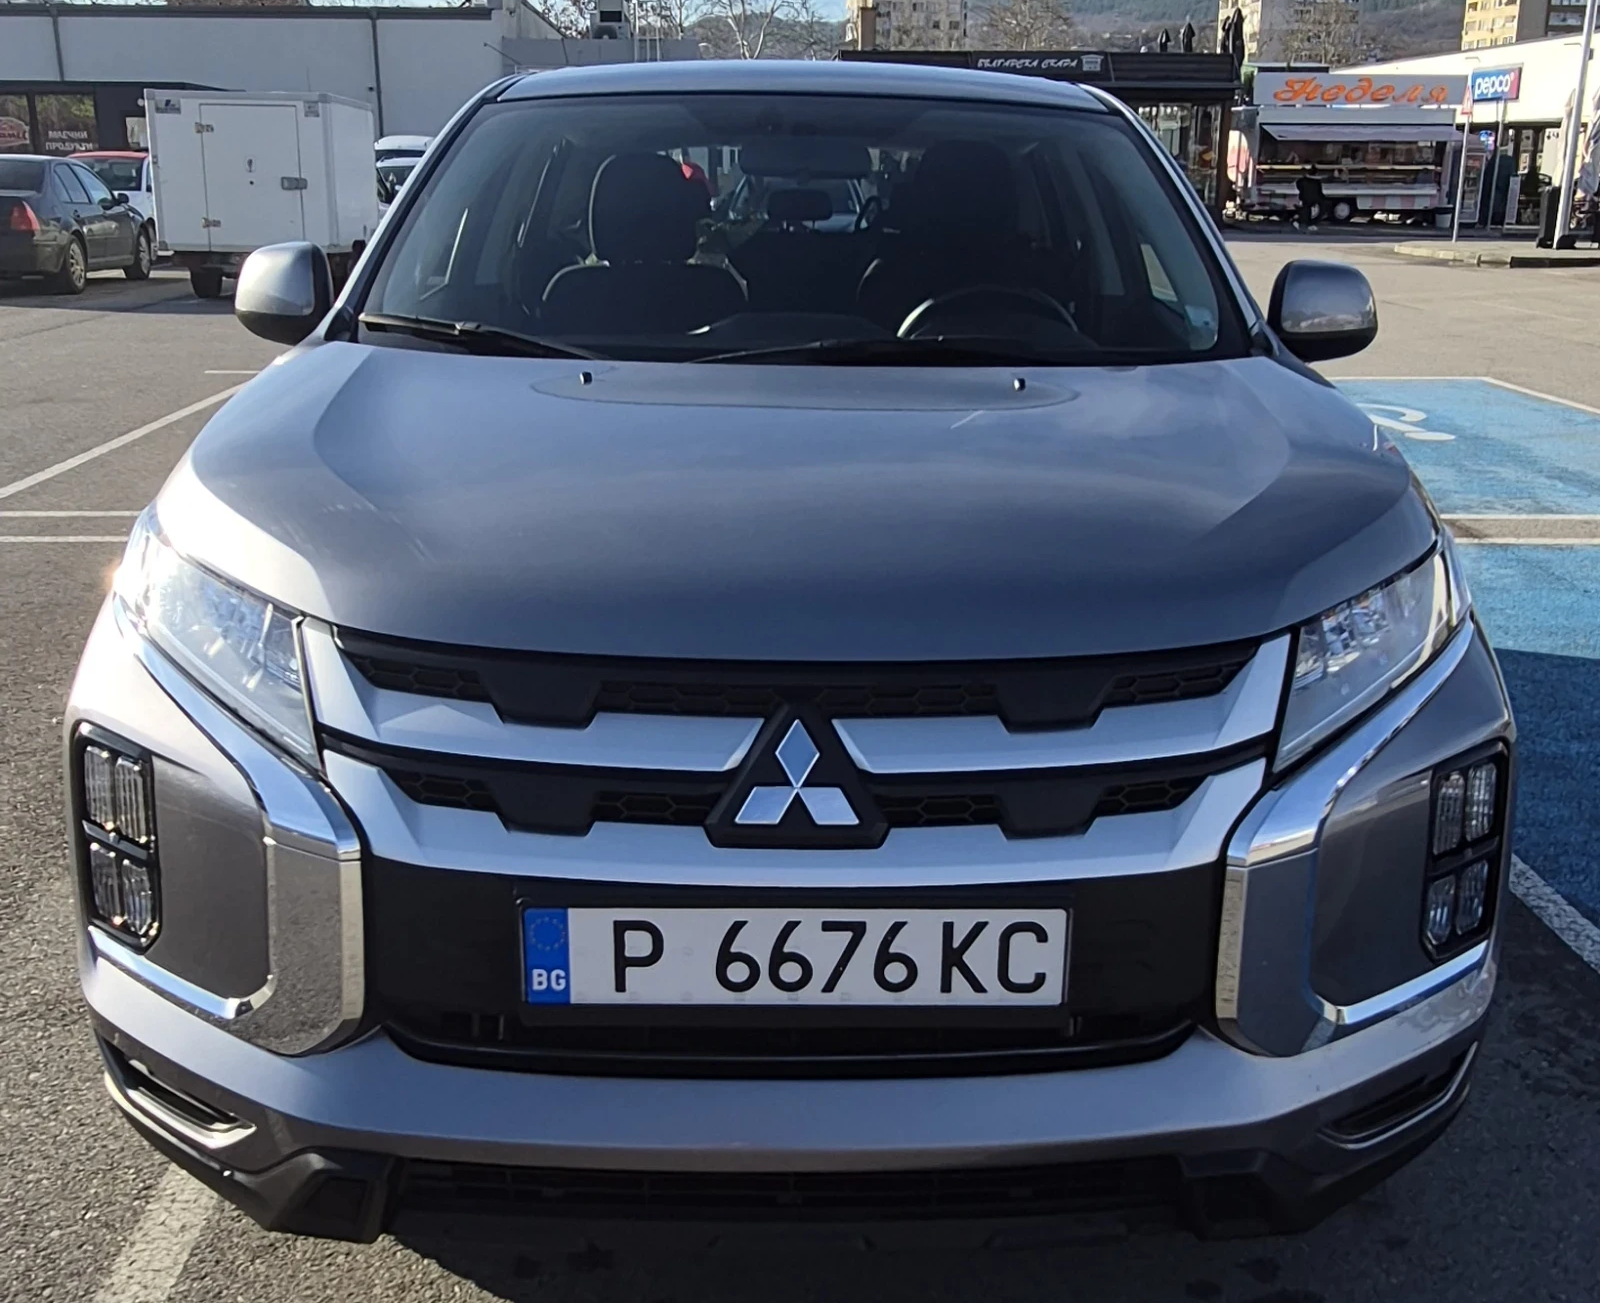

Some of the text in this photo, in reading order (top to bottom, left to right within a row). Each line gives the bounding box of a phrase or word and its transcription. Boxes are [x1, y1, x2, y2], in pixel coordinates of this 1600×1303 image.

[1273, 76, 1448, 103] Неделя
[1474, 73, 1511, 100] pepco
[613, 920, 664, 993] P
[715, 920, 918, 993] 6676
[532, 968, 567, 991] BG
